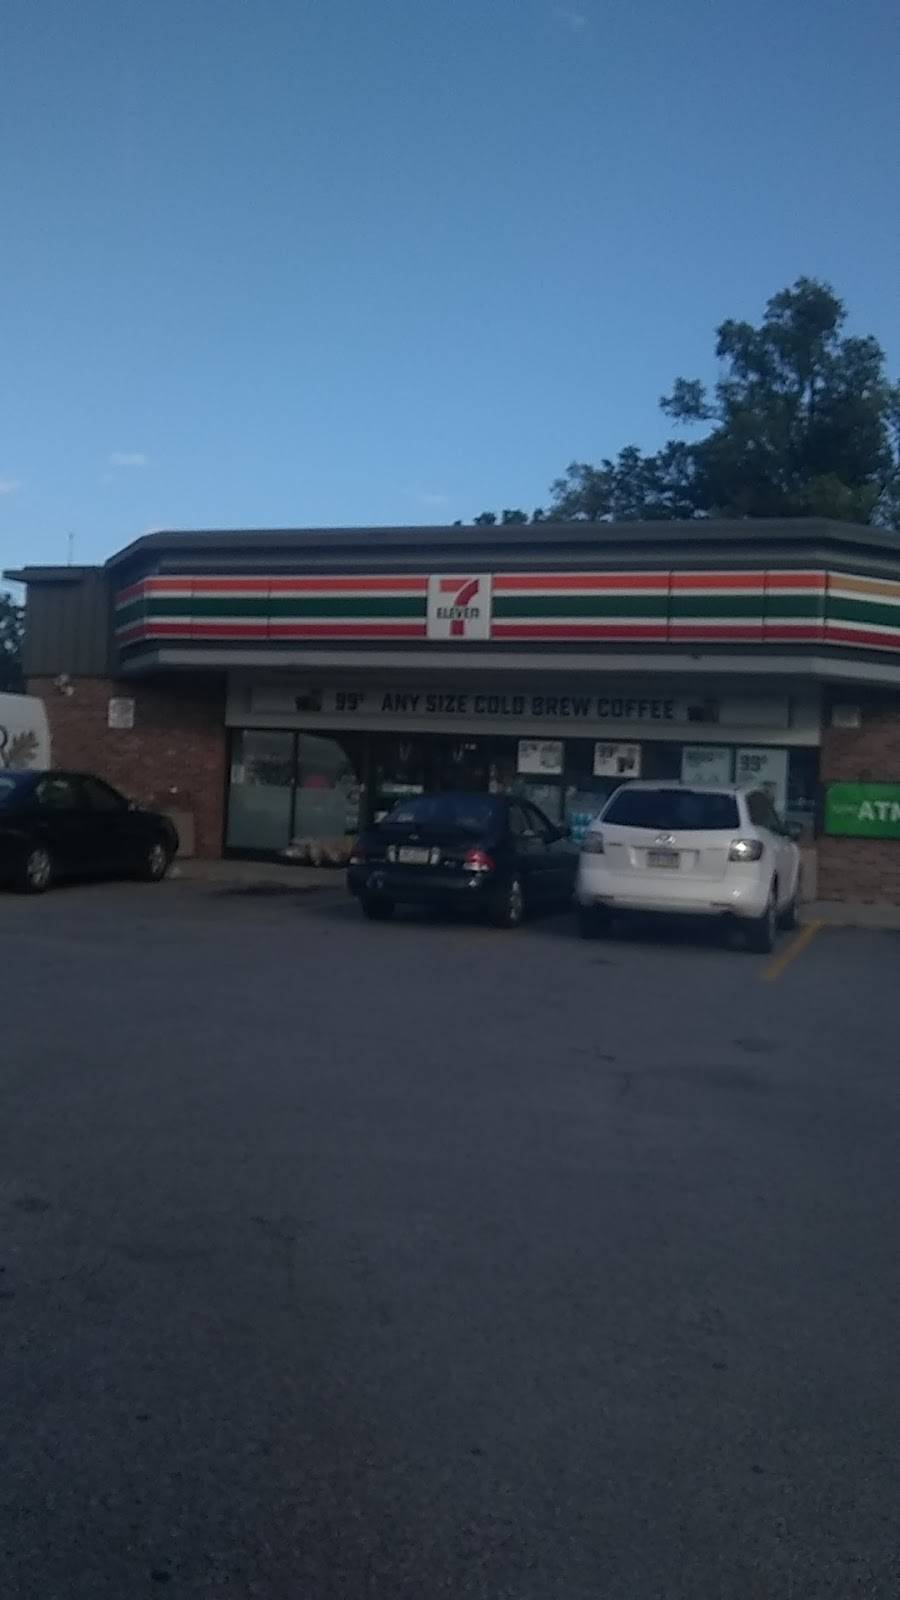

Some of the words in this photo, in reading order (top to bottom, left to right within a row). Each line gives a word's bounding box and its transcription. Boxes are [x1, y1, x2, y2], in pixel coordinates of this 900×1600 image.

[439, 579, 480, 635] 7
[381, 692, 420, 713] ANY
[426, 694, 467, 713] SIZE
[473, 695, 525, 715] COLD
[531, 696, 591, 717] BREW
[597, 698, 674, 719] COFFEE
